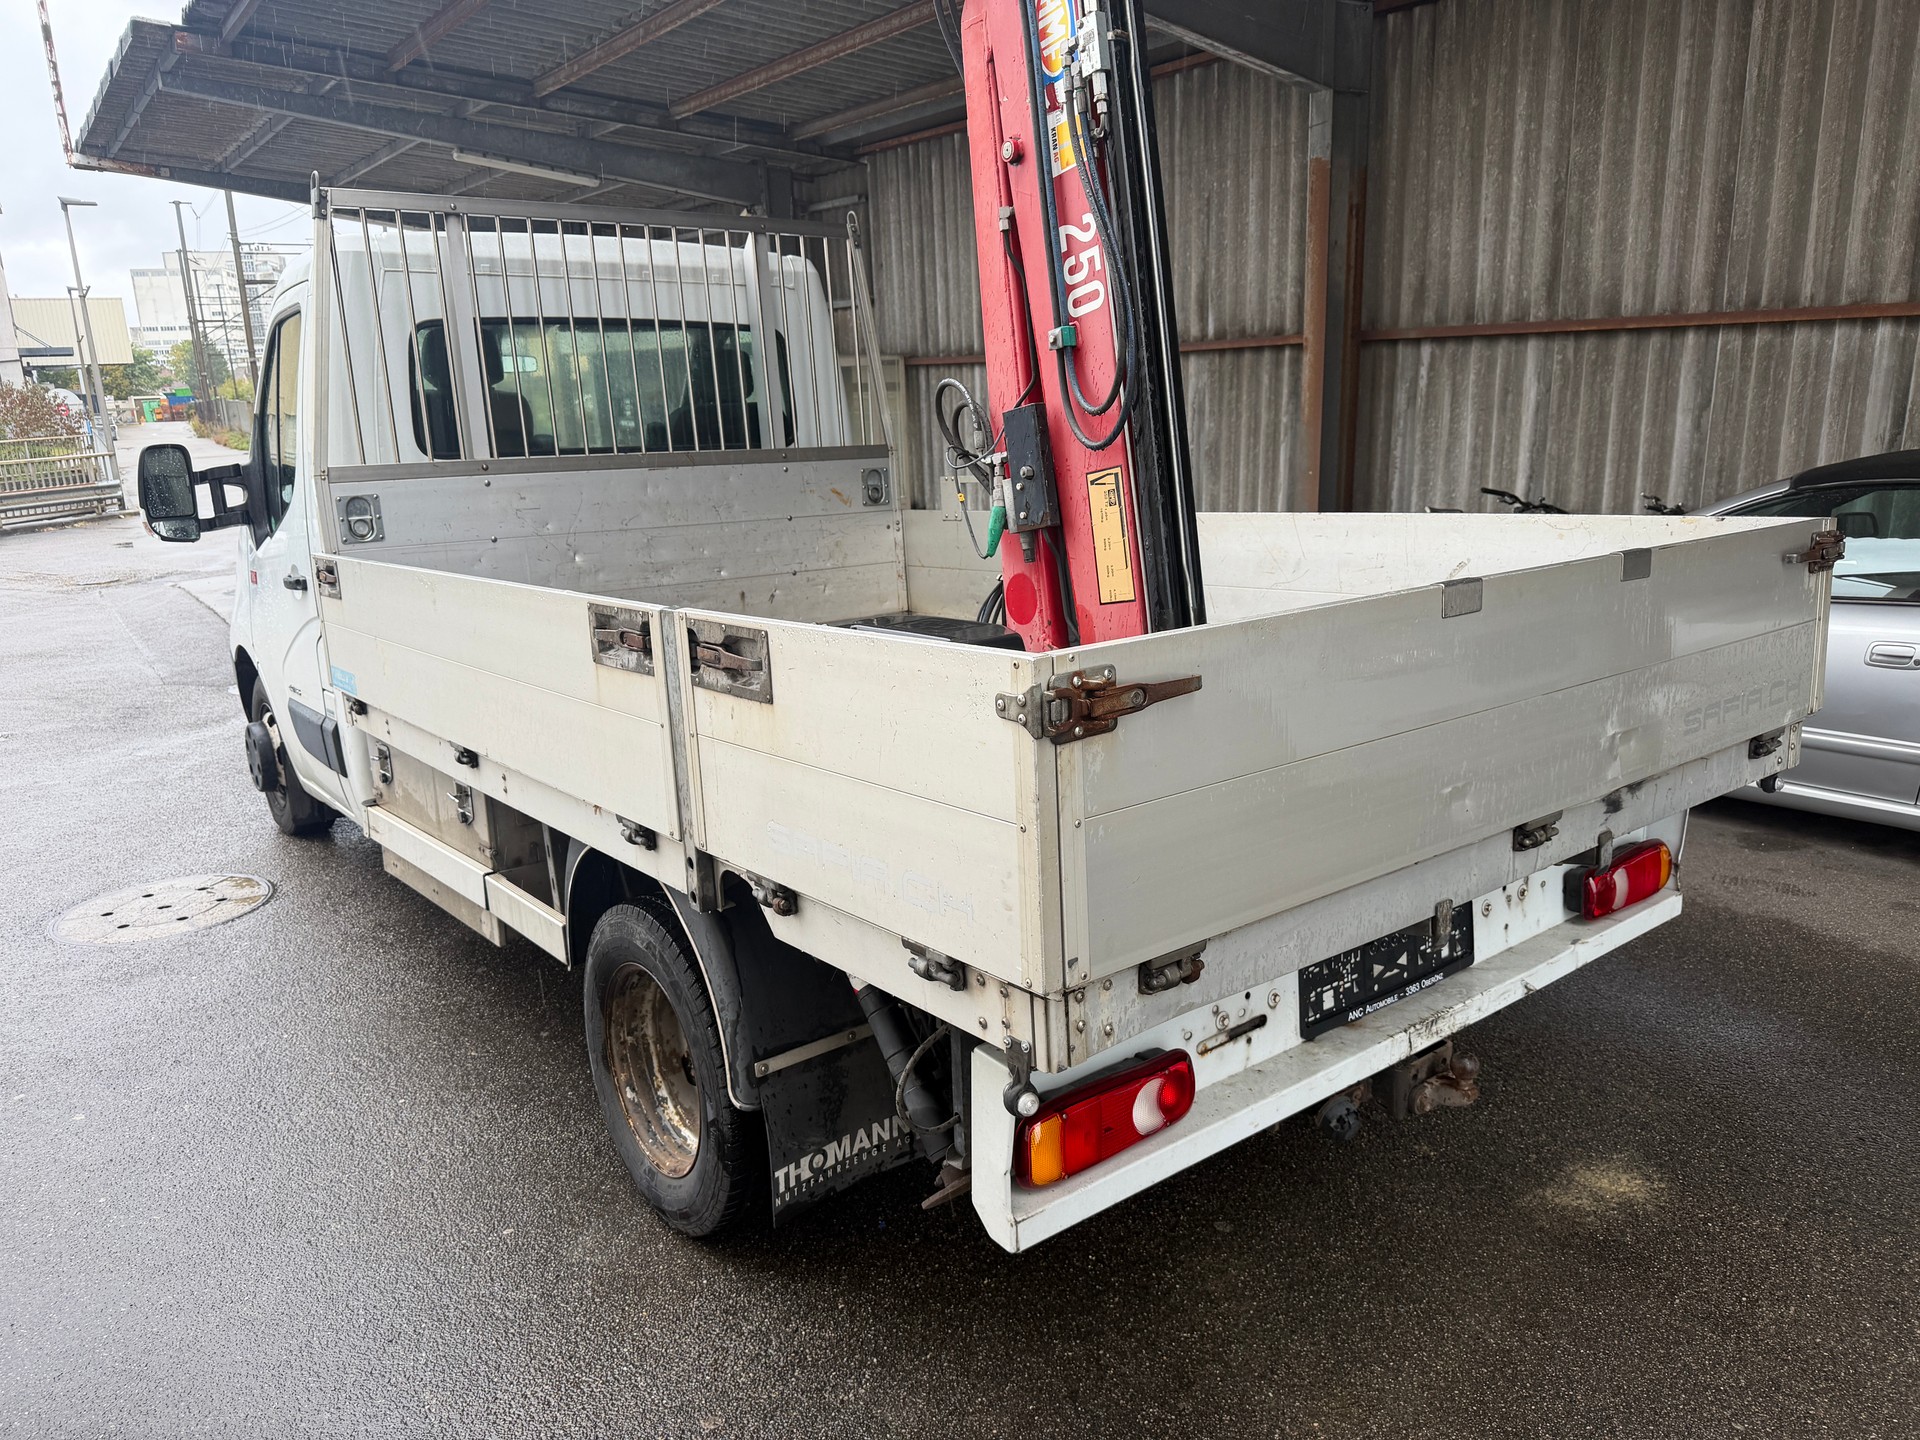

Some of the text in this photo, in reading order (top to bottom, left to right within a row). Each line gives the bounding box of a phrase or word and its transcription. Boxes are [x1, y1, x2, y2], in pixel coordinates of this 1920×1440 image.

[1050, 126, 1059, 150] KRAN
[1053, 150, 1060, 163] AG
[1058, 212, 1105, 318] 250
[1347, 1007, 1364, 1022] ANC
[1405, 982, 1420, 996] 3363
[775, 1136, 911, 1208] NUTZFAHRZEUGE AG
